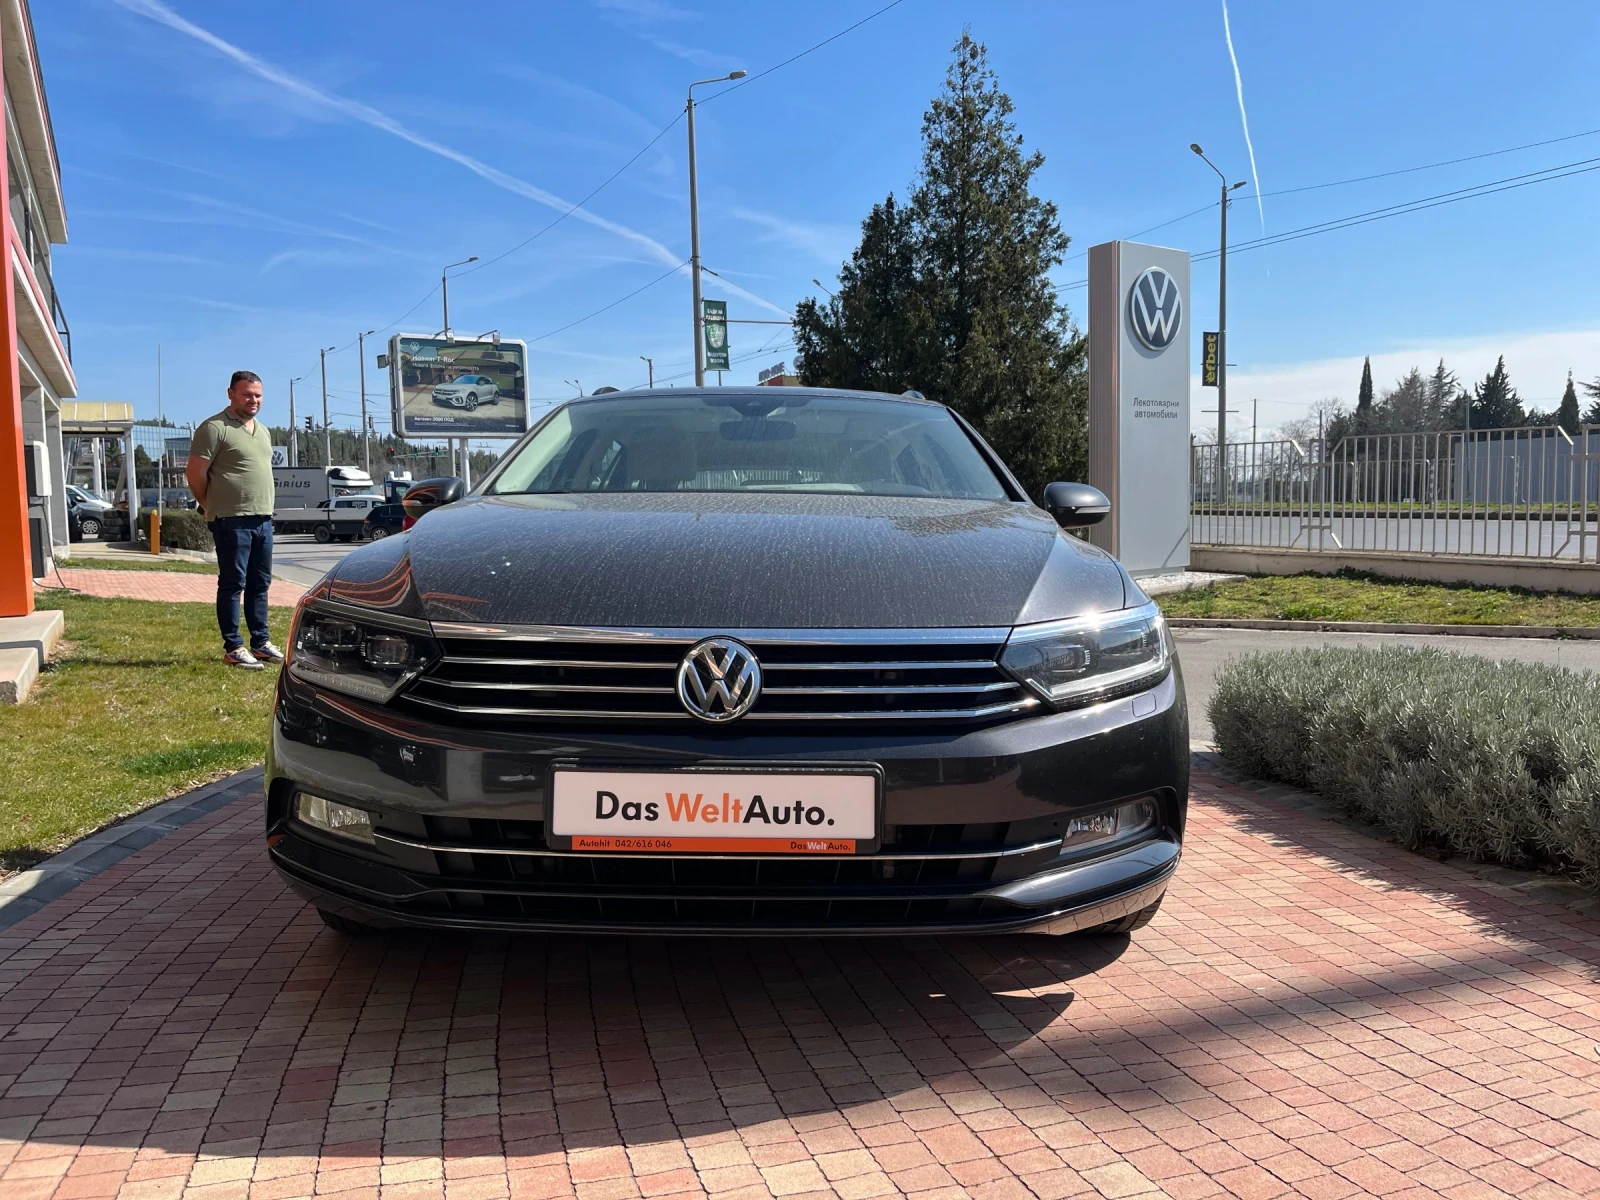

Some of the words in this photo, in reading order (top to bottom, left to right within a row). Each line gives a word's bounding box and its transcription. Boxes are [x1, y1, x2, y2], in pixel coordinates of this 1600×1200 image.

[1205, 334, 1217, 383] efbet
[1133, 397, 1179, 408] Лекотоварни
[1134, 410, 1178, 419] автомобили
[579, 839, 610, 848] Autohit
[615, 839, 653, 849] 042/616
[655, 840, 672, 848] 046
